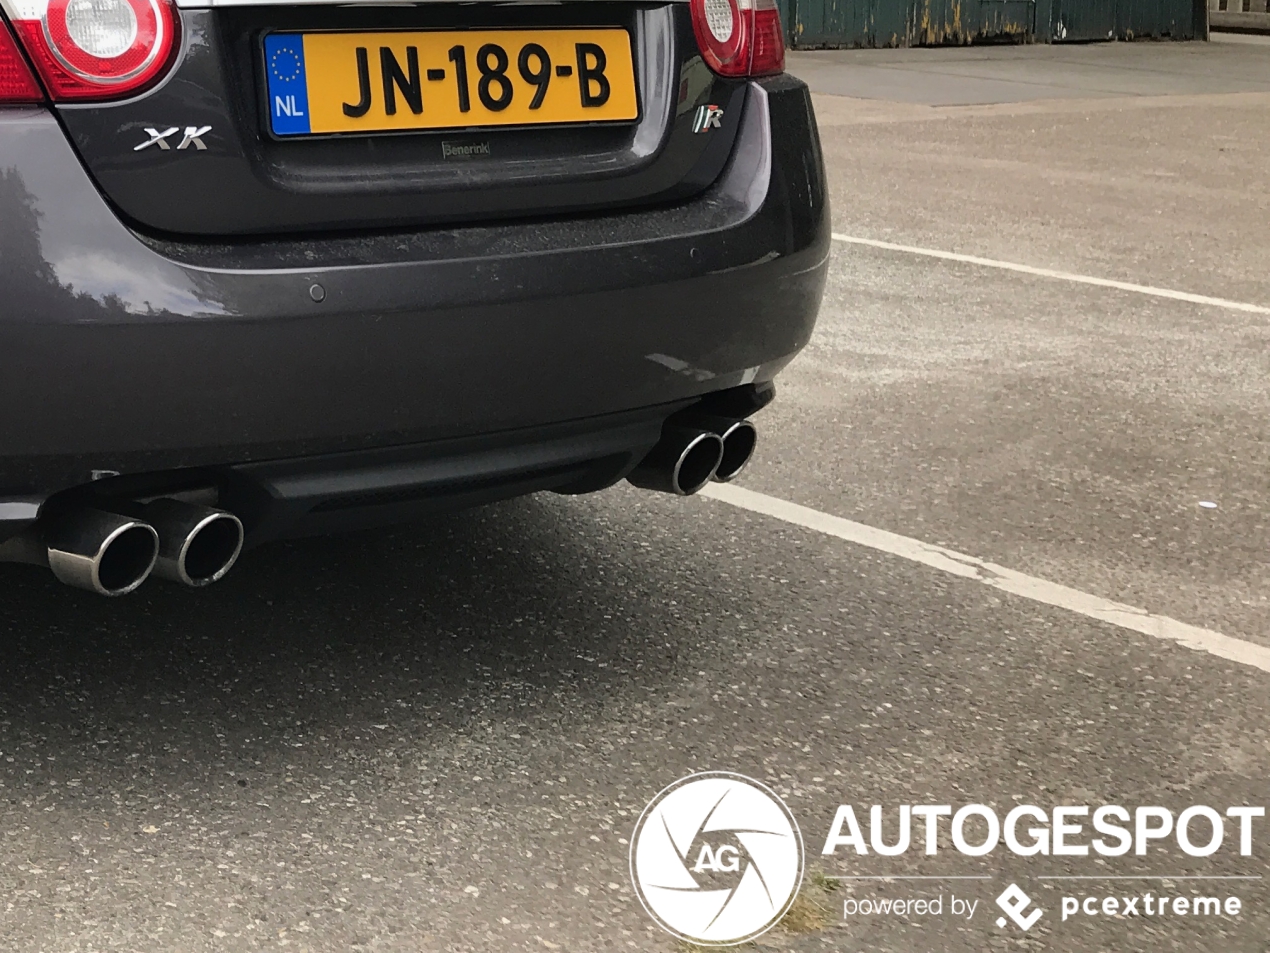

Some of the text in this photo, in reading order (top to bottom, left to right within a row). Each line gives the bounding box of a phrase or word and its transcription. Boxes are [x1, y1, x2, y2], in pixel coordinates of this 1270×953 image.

[342, 42, 611, 118] JN-189-B
[275, 95, 304, 117] NL
[133, 125, 213, 151] XK
